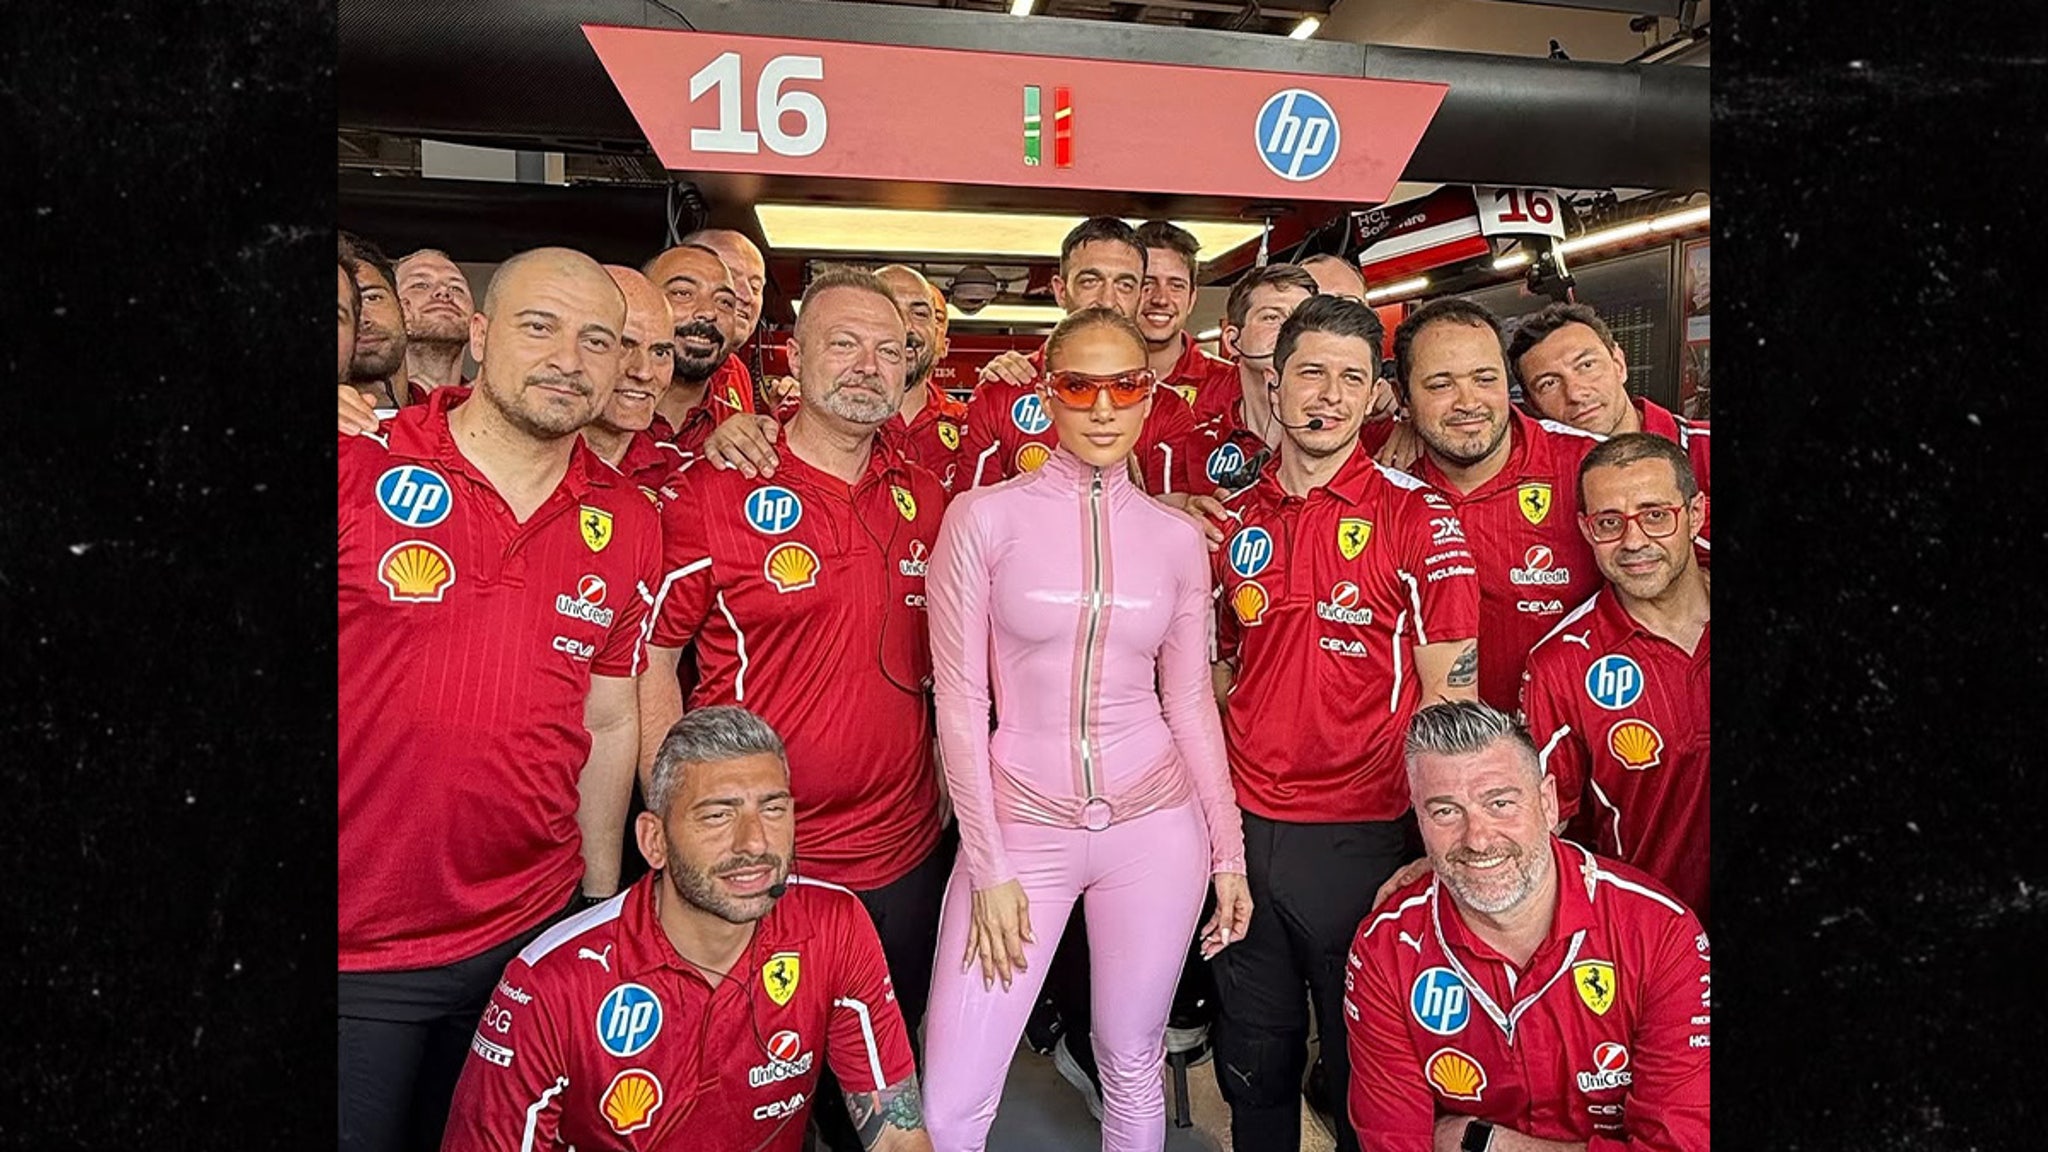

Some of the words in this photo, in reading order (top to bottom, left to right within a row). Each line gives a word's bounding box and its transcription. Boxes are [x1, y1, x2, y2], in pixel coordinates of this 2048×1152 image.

[690, 51, 827, 155] 16
[1265, 91, 1331, 178] hp
[1358, 210, 1391, 227] HCL
[1495, 188, 1553, 224] 16
[387, 466, 445, 524] hp
[755, 489, 793, 533] hp
[1235, 528, 1267, 576] hp
[1510, 568, 1569, 585] UniCredit
[1596, 657, 1634, 707] hp
[605, 986, 655, 1055] hp
[1420, 969, 1465, 1033] hp
[1577, 1072, 1632, 1092] UniCre
